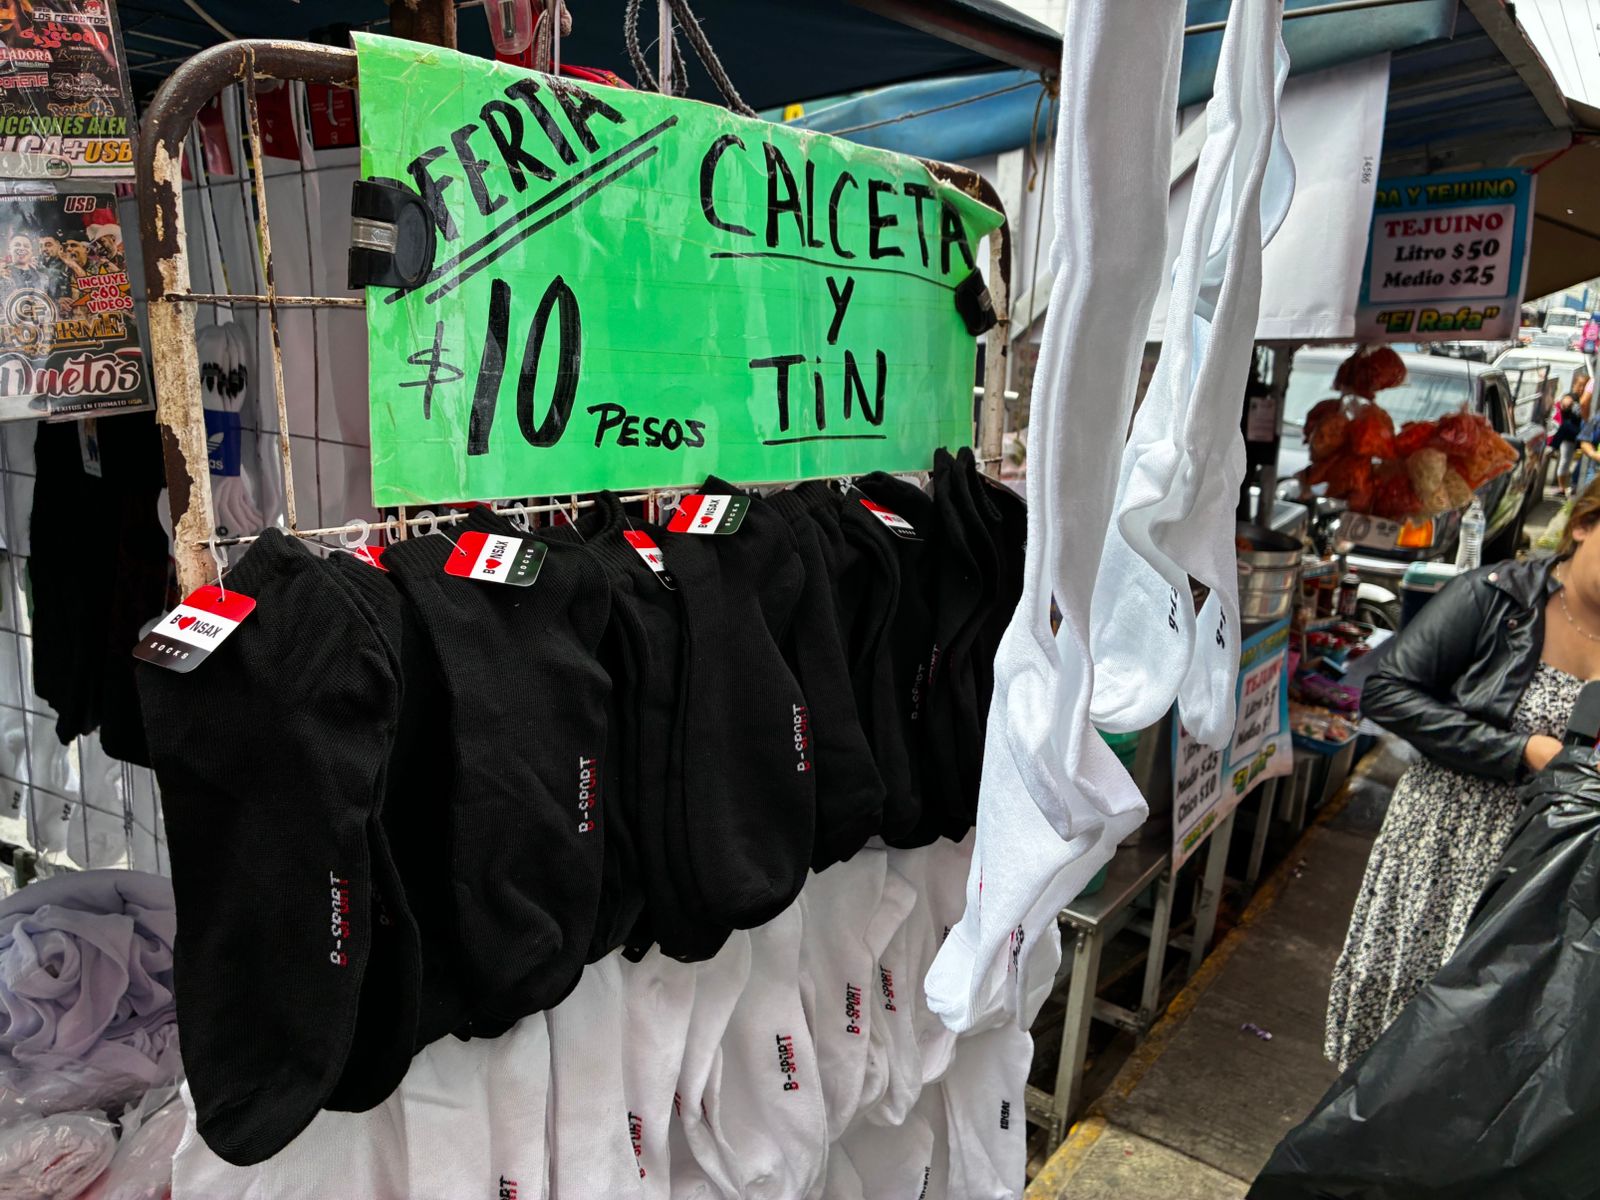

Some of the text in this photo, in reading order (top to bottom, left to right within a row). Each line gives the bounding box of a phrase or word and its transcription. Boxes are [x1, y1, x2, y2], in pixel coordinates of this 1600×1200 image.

[87, 117, 127, 135] ALEX
[405, 76, 626, 241] FERTA
[700, 133, 976, 275] CALCETA
[1426, 178, 1517, 204] TEJUINO
[65, 196, 96, 213] USB
[1385, 213, 1503, 238] TEJUINO
[1394, 239, 1500, 262] Litro $50
[77, 273, 128, 290] INCLUYE
[1382, 266, 1496, 288] Medio $25
[87, 297, 134, 314] VIDEOS
[826, 276, 855, 345] Y
[587, 403, 708, 449] PESOS
[150, 642, 190, 660] SOCKS
[330, 870, 350, 967] B-SPORT
[880, 964, 897, 1013] B-SPORT
[846, 982, 862, 1035] B-SPORT
[776, 1034, 800, 1091] B-SPORT
